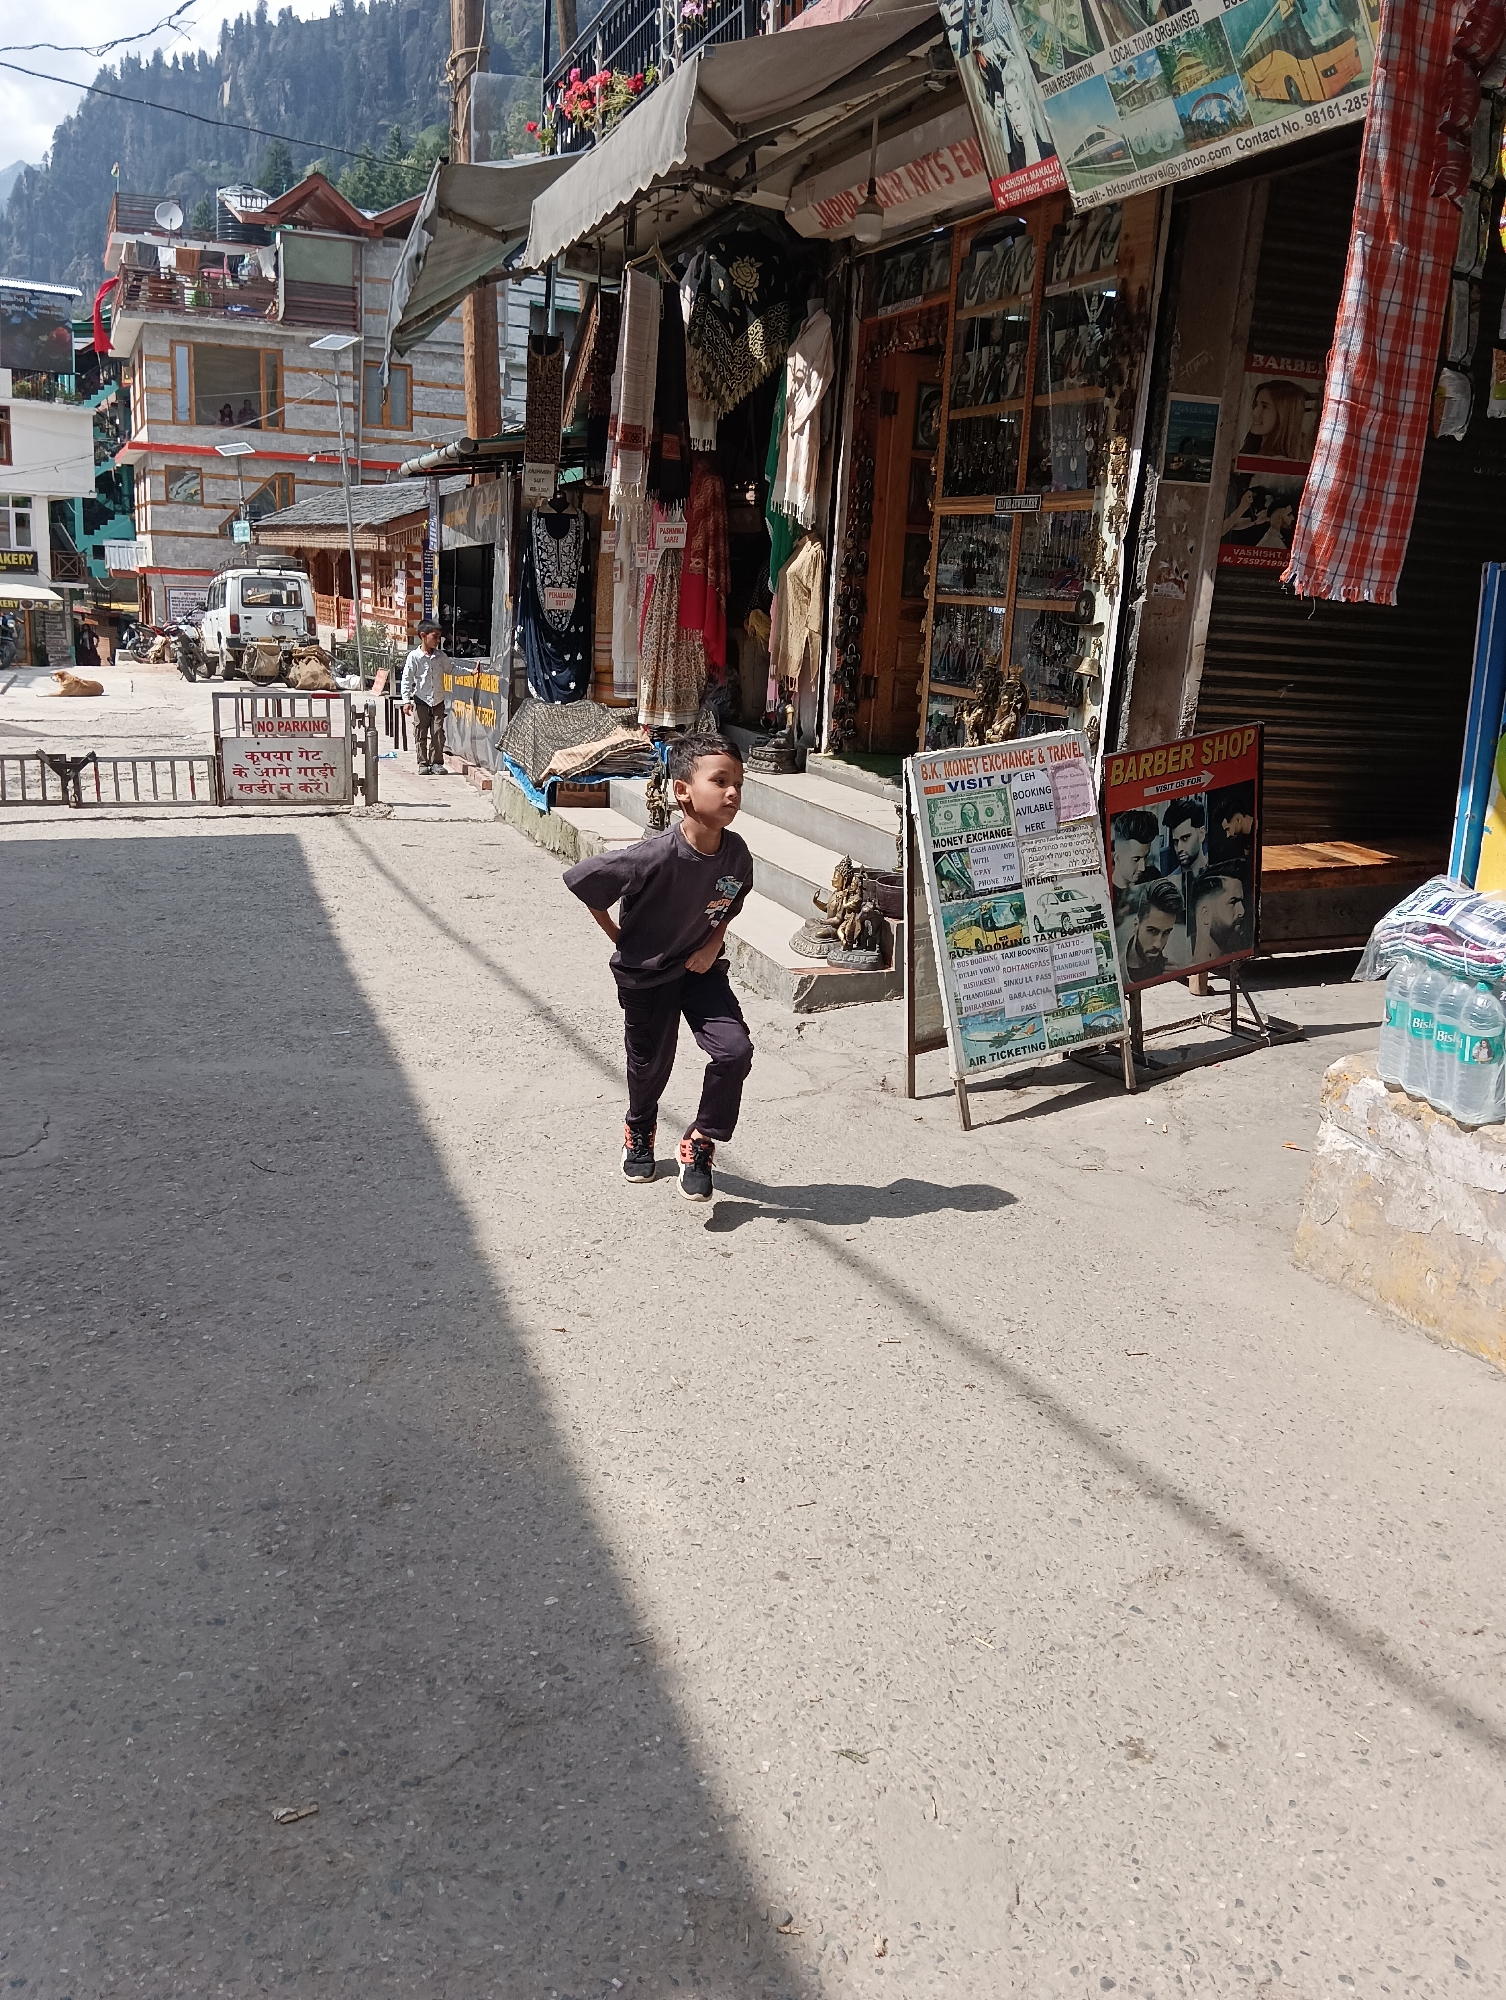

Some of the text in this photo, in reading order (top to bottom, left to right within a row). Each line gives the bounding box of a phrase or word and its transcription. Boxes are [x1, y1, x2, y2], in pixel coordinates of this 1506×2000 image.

[1108, 9, 1201, 65] LOCAL TOUR ORGANISED
[1041, 62, 1096, 98] TRAIN RESERVATION
[1105, 144, 1232, 199] bktourntravel@yahoo.com
[1236, 124, 1281, 151] Contact
[1281, 119, 1304, 136] No.
[1304, 91, 1371, 127] 98161-285
[903, 151, 955, 197] ARTS
[1030, 162, 1054, 180] MANALI
[257, 719, 329, 733] NO PARKING
[244, 746, 323, 765] कृपया गेट
[921, 741, 1085, 781] B.K. MONEY EXCHANGE & TRAVEL
[1110, 728, 1256, 787] BARBER SHOP
[232, 762, 337, 779] के आगे गाड़ी
[1020, 771, 1036, 782] LEH
[280, 783, 294, 794] न
[947, 775, 995, 793] VISIT
[1155, 782, 1175, 793] VISIT
[1187, 776, 1202, 786] FOR
[1012, 785, 1052, 801] BOOKING
[1015, 801, 1054, 817] AVILABLE
[1025, 820, 1046, 833] HERE
[932, 827, 1013, 849] MONEY EXCHANGE
[970, 841, 1016, 854] CASH ADVANCE
[972, 857, 990, 866] WITH
[978, 875, 1015, 887] PHONE PAY
[949, 920, 1108, 960] BUS BOOKING TAXI BOOKING
[1057, 940, 1072, 950] TAXI
[1001, 945, 1049, 960] TAXI BOOKING
[1068, 948, 1094, 959] AIRPORT
[957, 954, 998, 968] BUS BOOKING
[1002, 959, 1051, 974] ROHTANGPASS
[958, 964, 1000, 980] DELHI VOLVO
[1003, 972, 1052, 988] SINKU LA PASS
[1095, 973, 1117, 985] LEH
[1020, 1003, 1037, 1012] PASS
[969, 1041, 1046, 1068] AIR TICKETING
